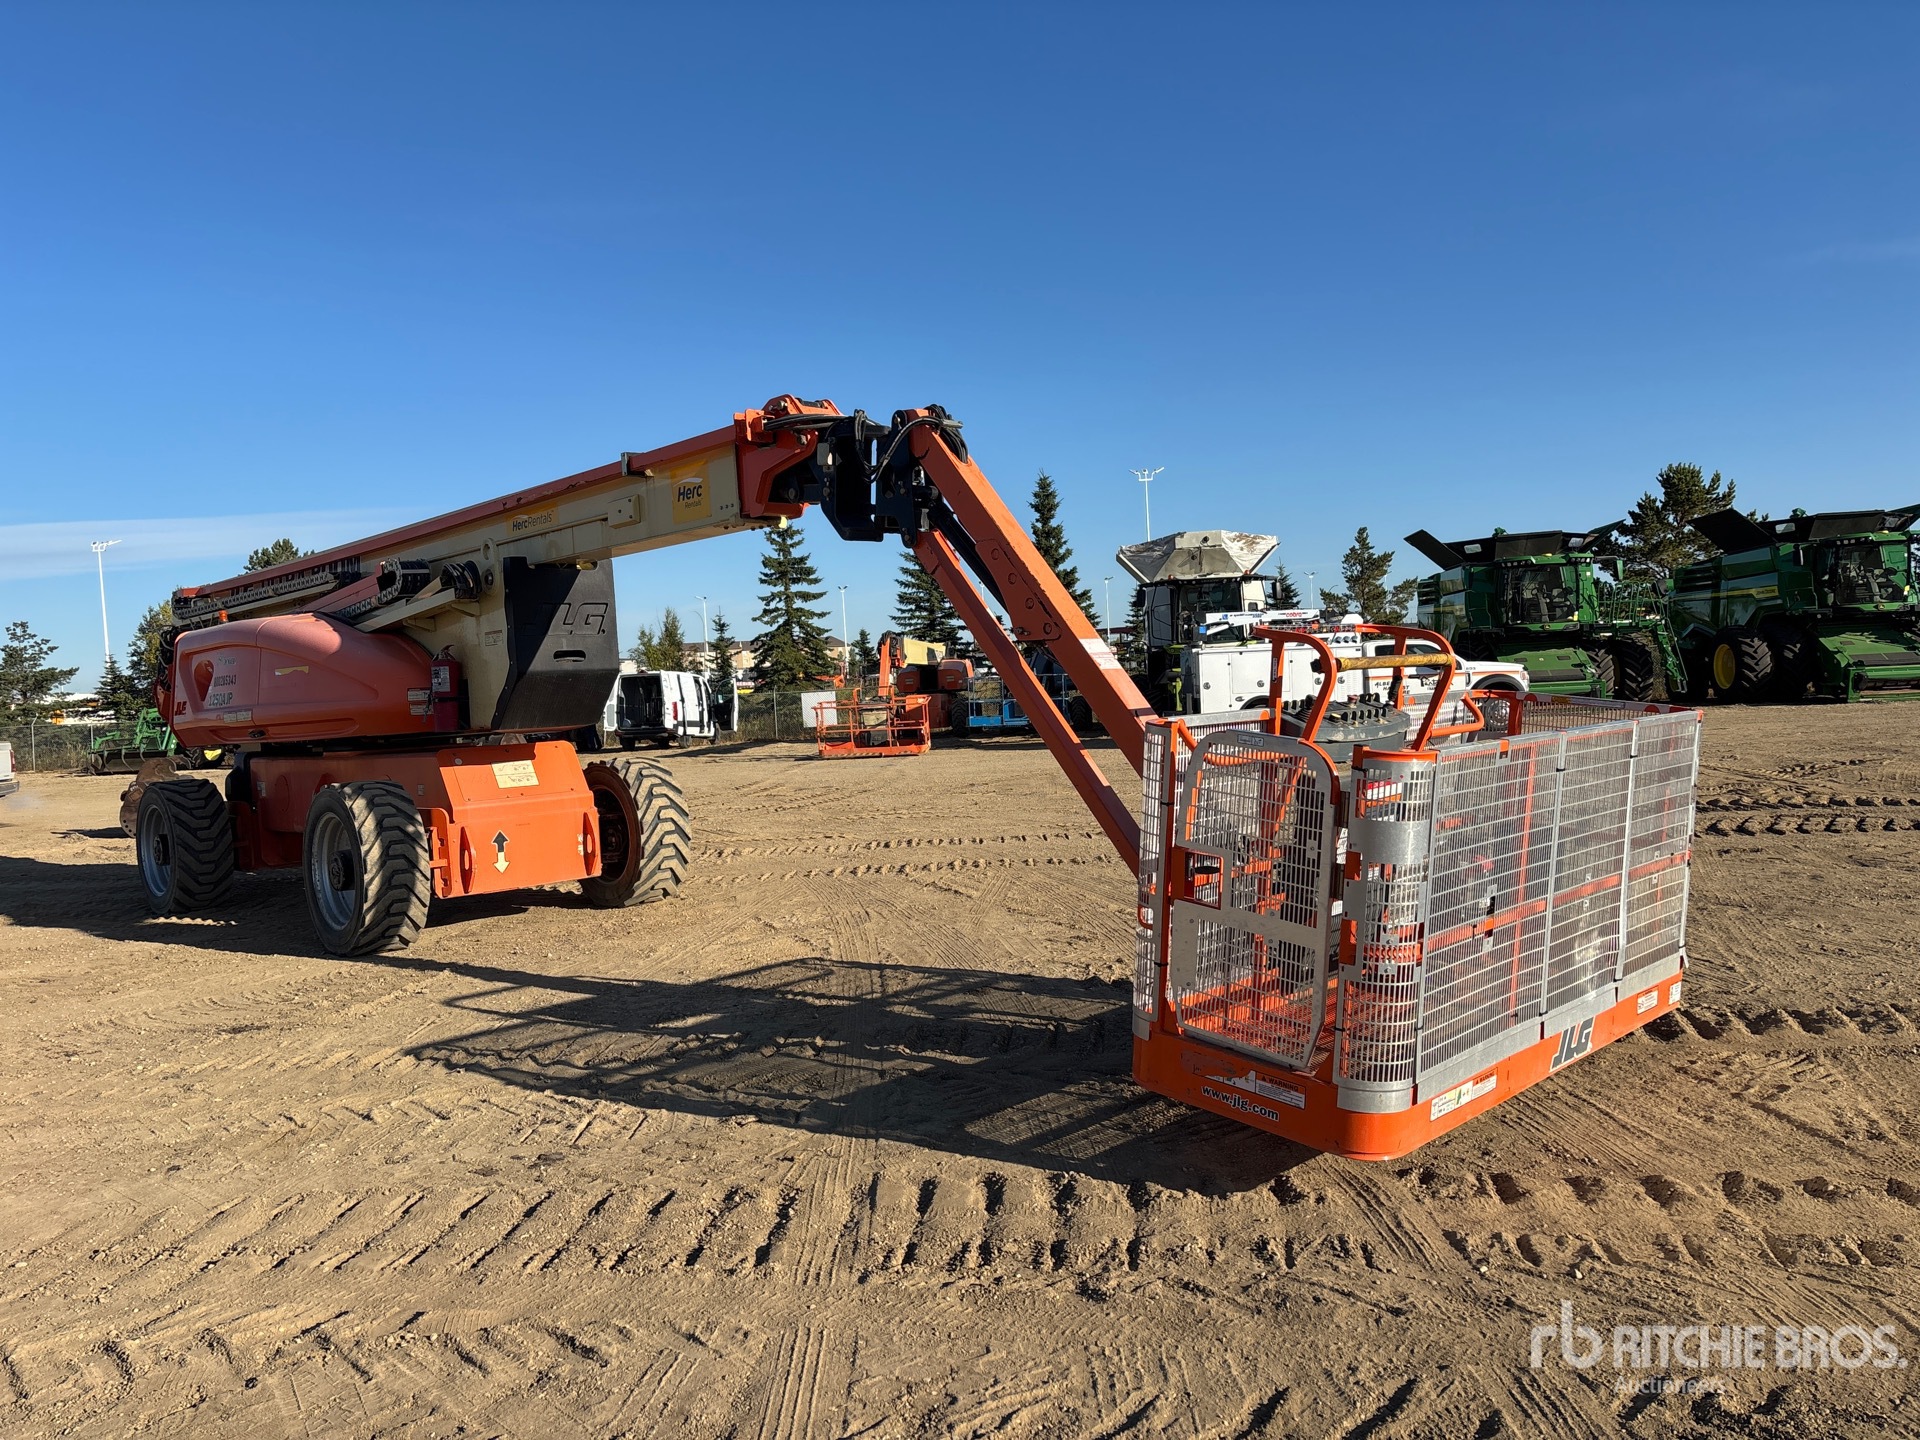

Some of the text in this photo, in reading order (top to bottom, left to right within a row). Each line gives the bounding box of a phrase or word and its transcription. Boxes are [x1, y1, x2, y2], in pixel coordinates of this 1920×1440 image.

[677, 484, 703, 503] Herc
[684, 499, 702, 509] Rentals
[1549, 1016, 1596, 1073] JLG
[1268, 1076, 1299, 1092] WARNING
[1201, 1085, 1280, 1122] www.jlg.com
